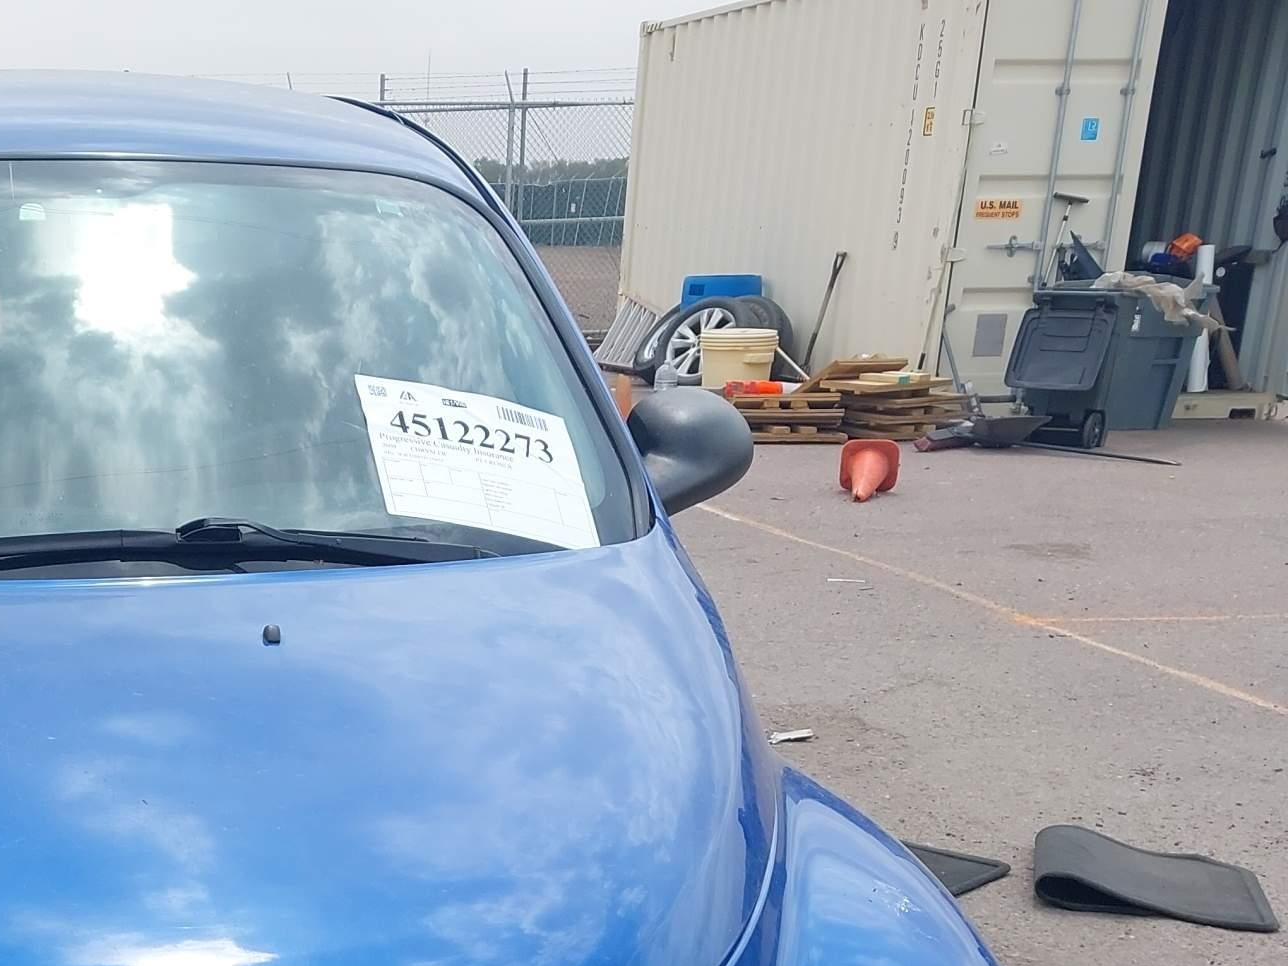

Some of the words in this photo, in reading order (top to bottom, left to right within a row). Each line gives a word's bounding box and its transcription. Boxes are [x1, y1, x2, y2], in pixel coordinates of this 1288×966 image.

[980, 200, 996, 209] U.S.
[998, 200, 1020, 210] MAIL
[379, 431, 431, 447] Progressive
[390, 410, 554, 464] 45122273
